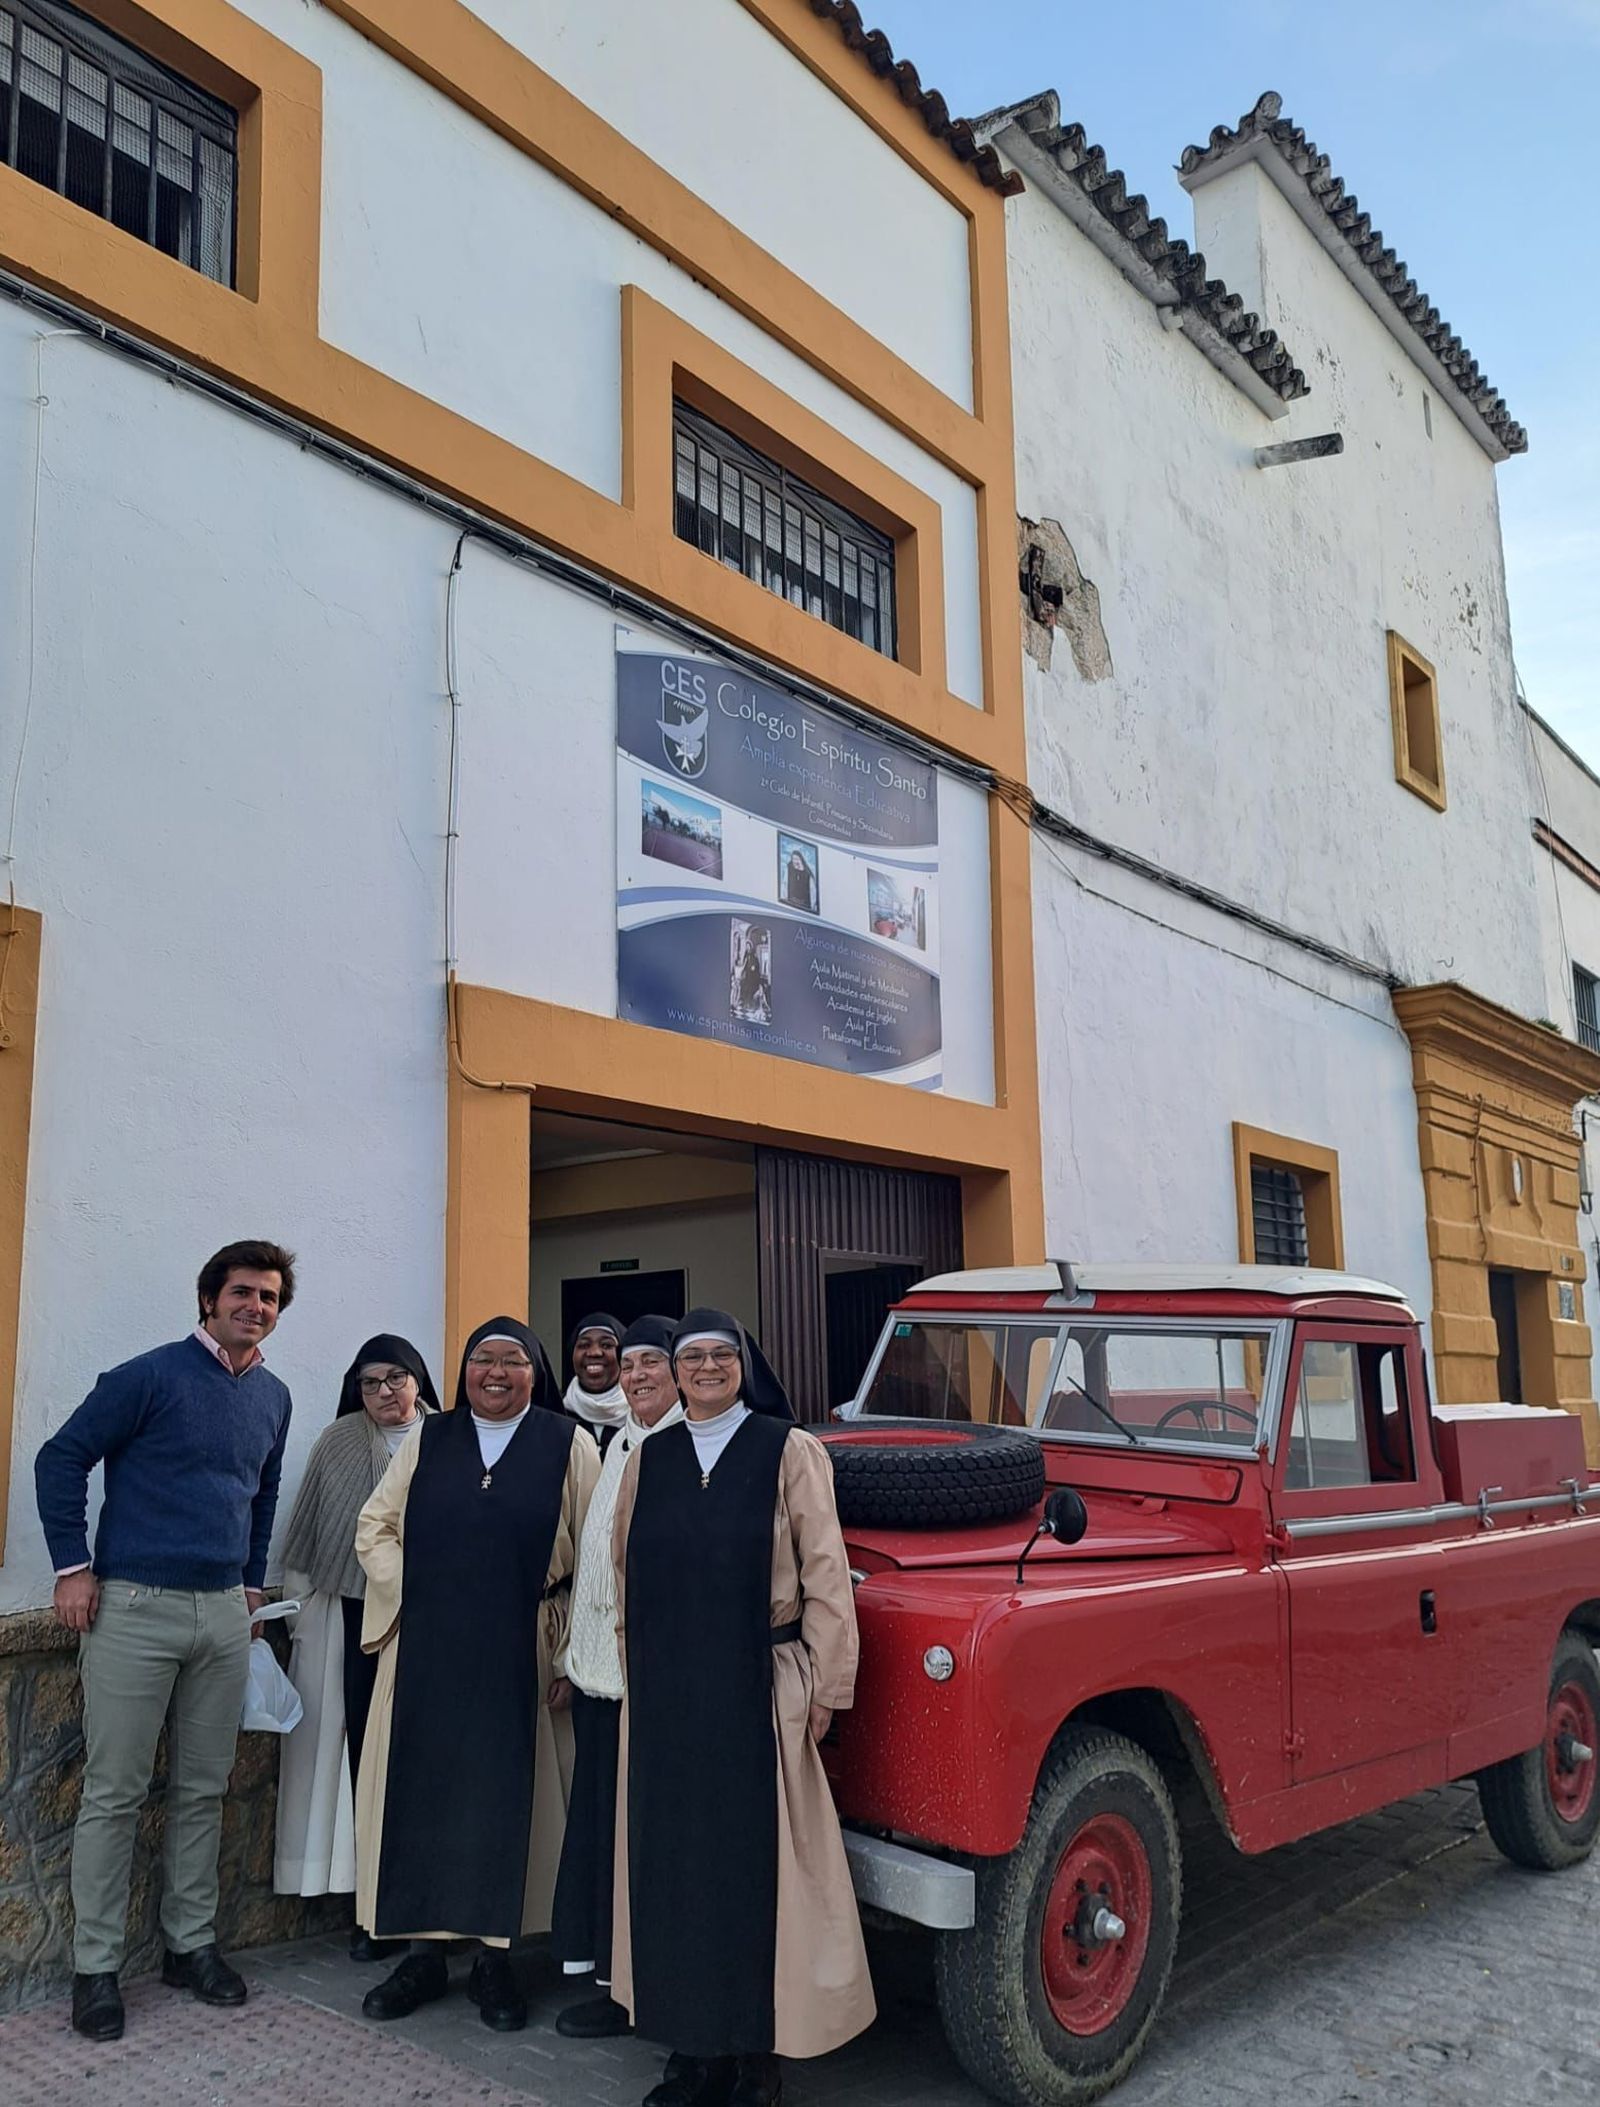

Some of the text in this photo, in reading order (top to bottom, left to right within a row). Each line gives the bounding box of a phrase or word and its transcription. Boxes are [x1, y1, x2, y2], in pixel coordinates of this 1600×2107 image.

[661, 660, 706, 704] CES
[717, 682, 927, 800] Colegio Espíritu Santo
[740, 735, 911, 823] Amplia experiencia Educativa
